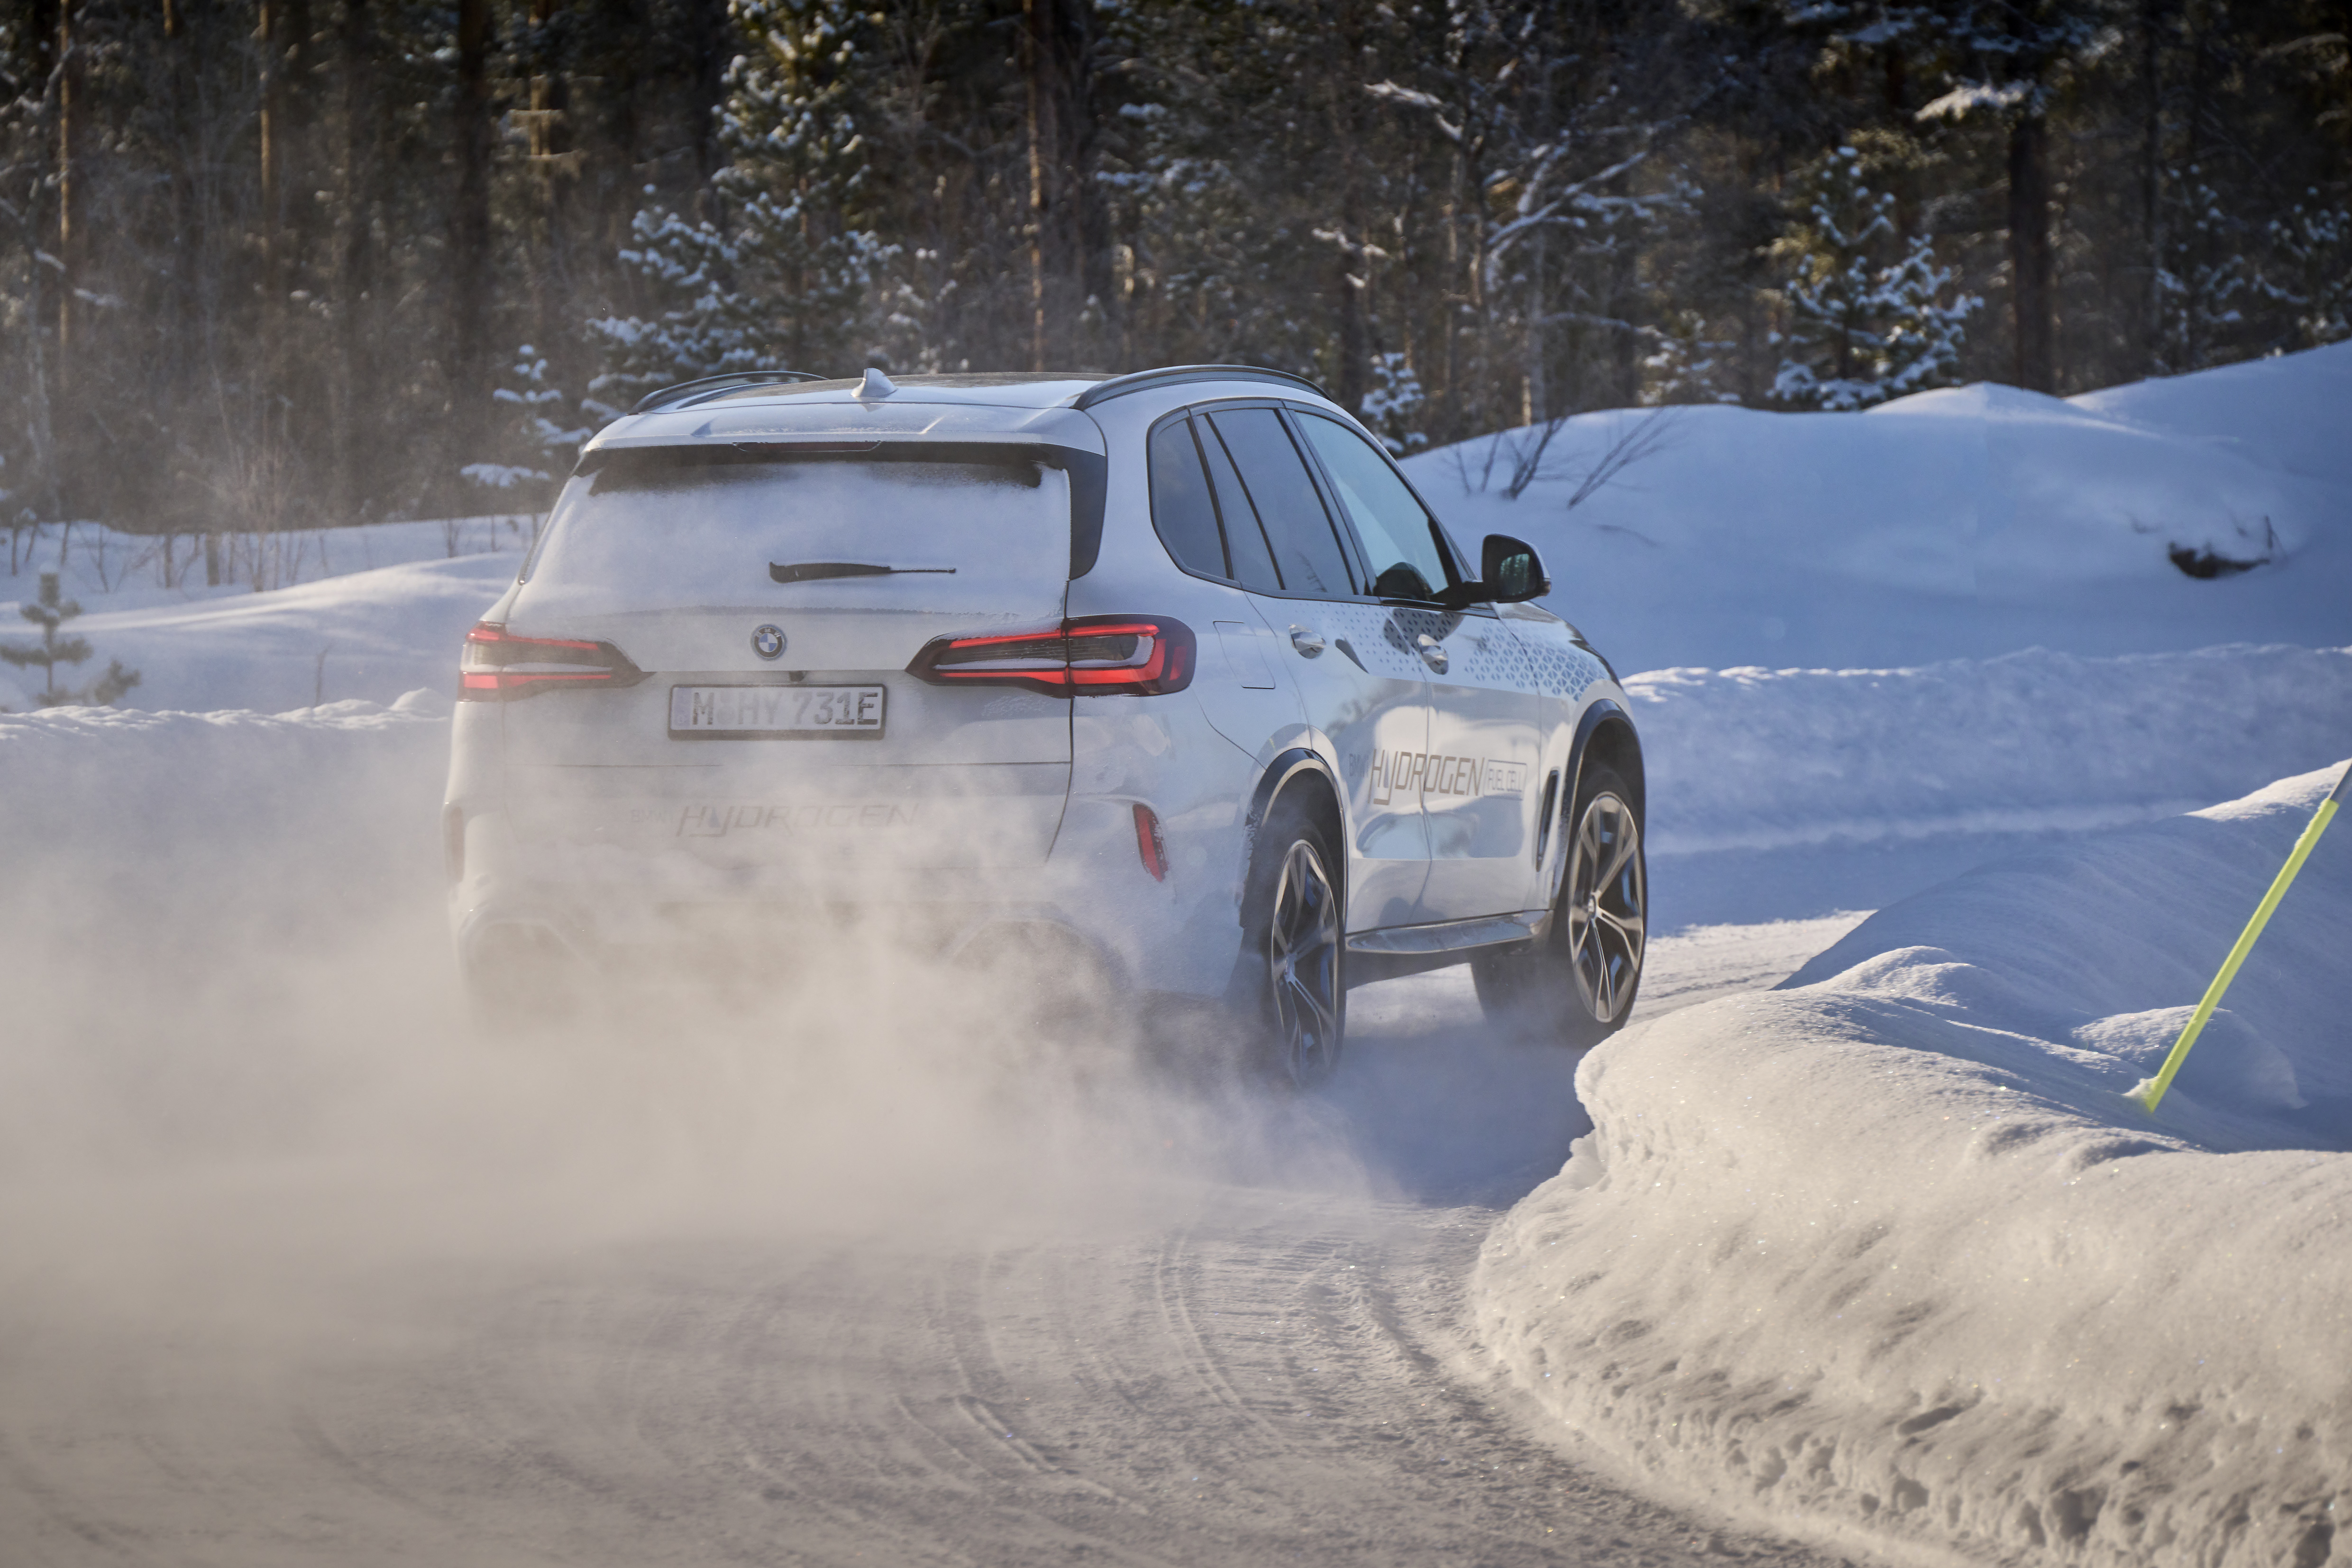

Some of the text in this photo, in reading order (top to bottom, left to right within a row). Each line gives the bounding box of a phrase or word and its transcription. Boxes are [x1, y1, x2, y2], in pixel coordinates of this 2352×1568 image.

[692, 692, 879, 725] M HY 731E
[1367, 749, 1485, 809] HYDROGEN
[1487, 768, 1505, 790] FUEL
[676, 803, 920, 838] HYDROGEN
